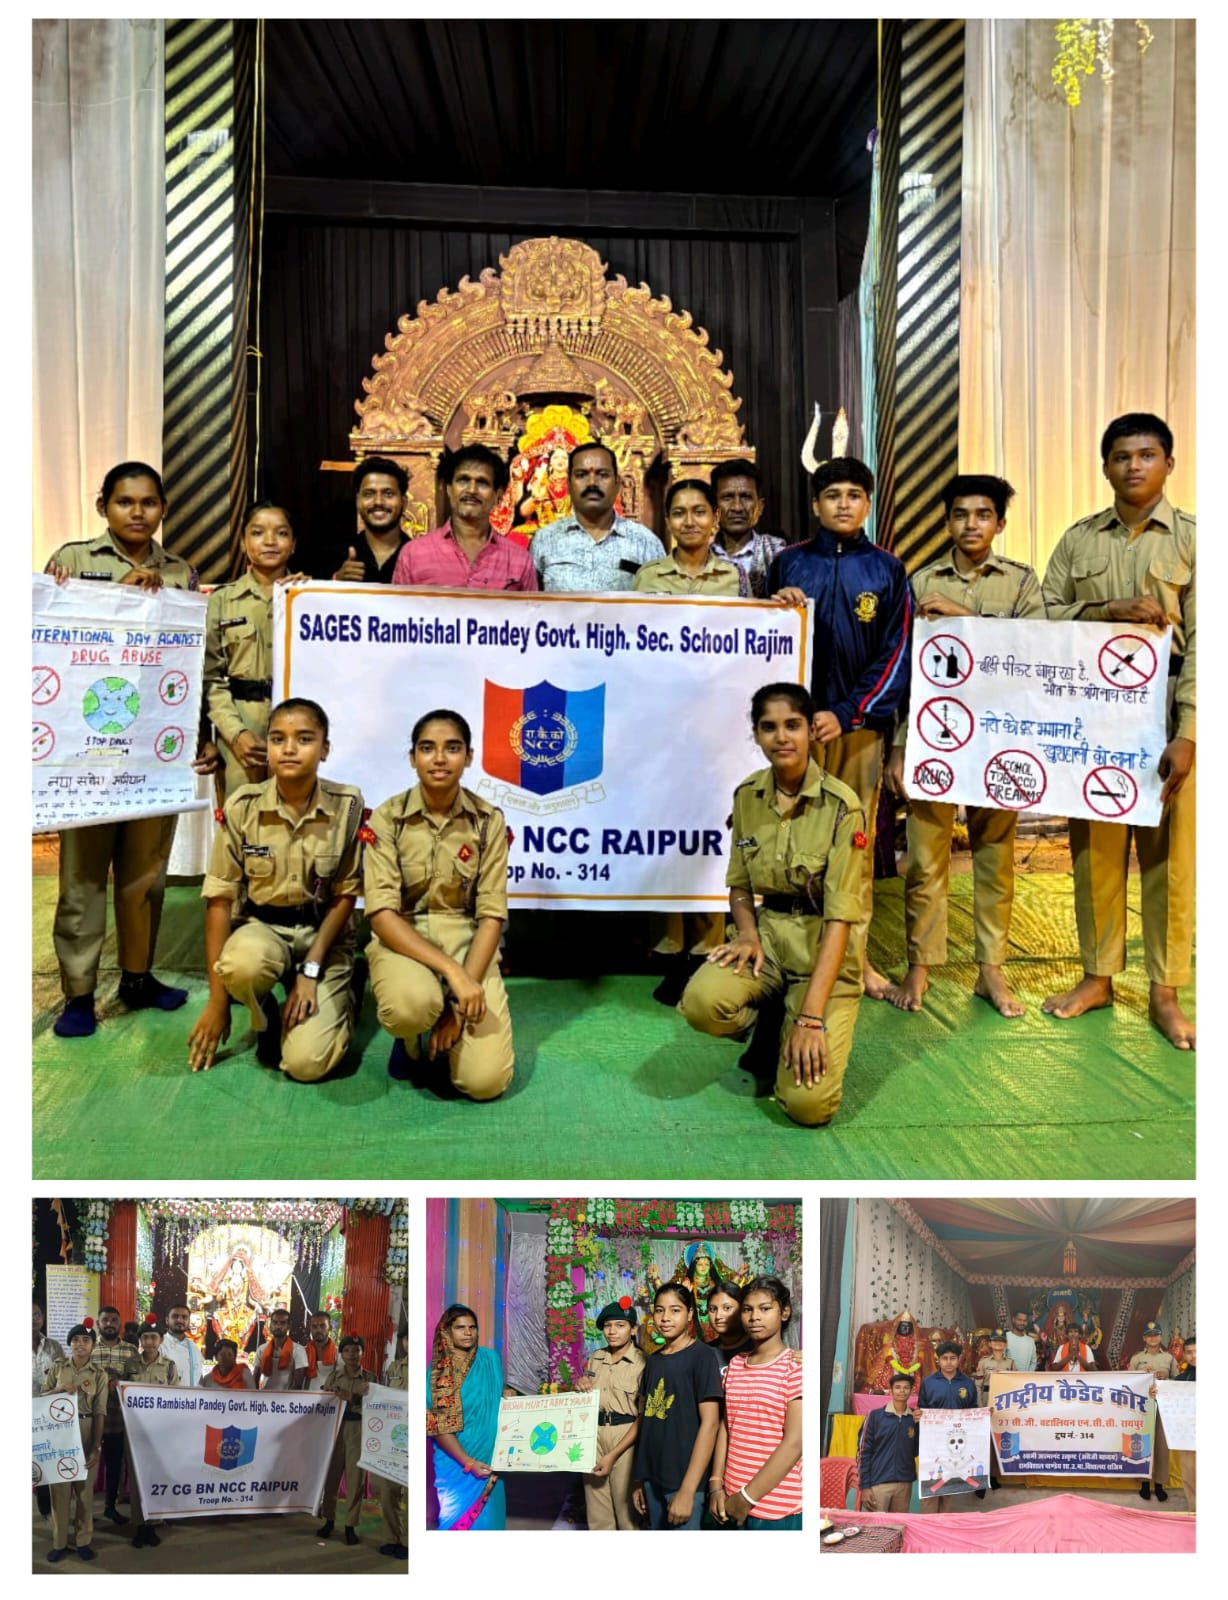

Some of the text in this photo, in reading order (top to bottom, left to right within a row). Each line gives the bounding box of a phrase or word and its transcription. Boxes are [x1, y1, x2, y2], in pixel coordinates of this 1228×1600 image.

[126, 632, 151, 646] DAY
[158, 632, 202, 646] AGAINST
[300, 613, 793, 662] SAGES Rambishal Pandey Govt. High. Sec. School Rajim
[71, 648, 162, 664] DRUG ABUSE
[524, 738, 561, 751] NCC
[523, 826, 723, 856] NCC RAIPUR
[531, 862, 560, 880] No.
[578, 864, 610, 881] 314
[994, 1379, 1149, 1413] राष्ट्रीय कैडेट कोर
[127, 1396, 336, 1417] SAGES Rambishal Pandey Govt. High. Sec. School Rajim
[1080, 1432, 1095, 1440] 314
[151, 1481, 299, 1496] 27 CG BN NCC RAIPUR
[199, 1497, 220, 1505] Troop
[221, 1496, 234, 1504] No.
[240, 1495, 254, 1503] 314
